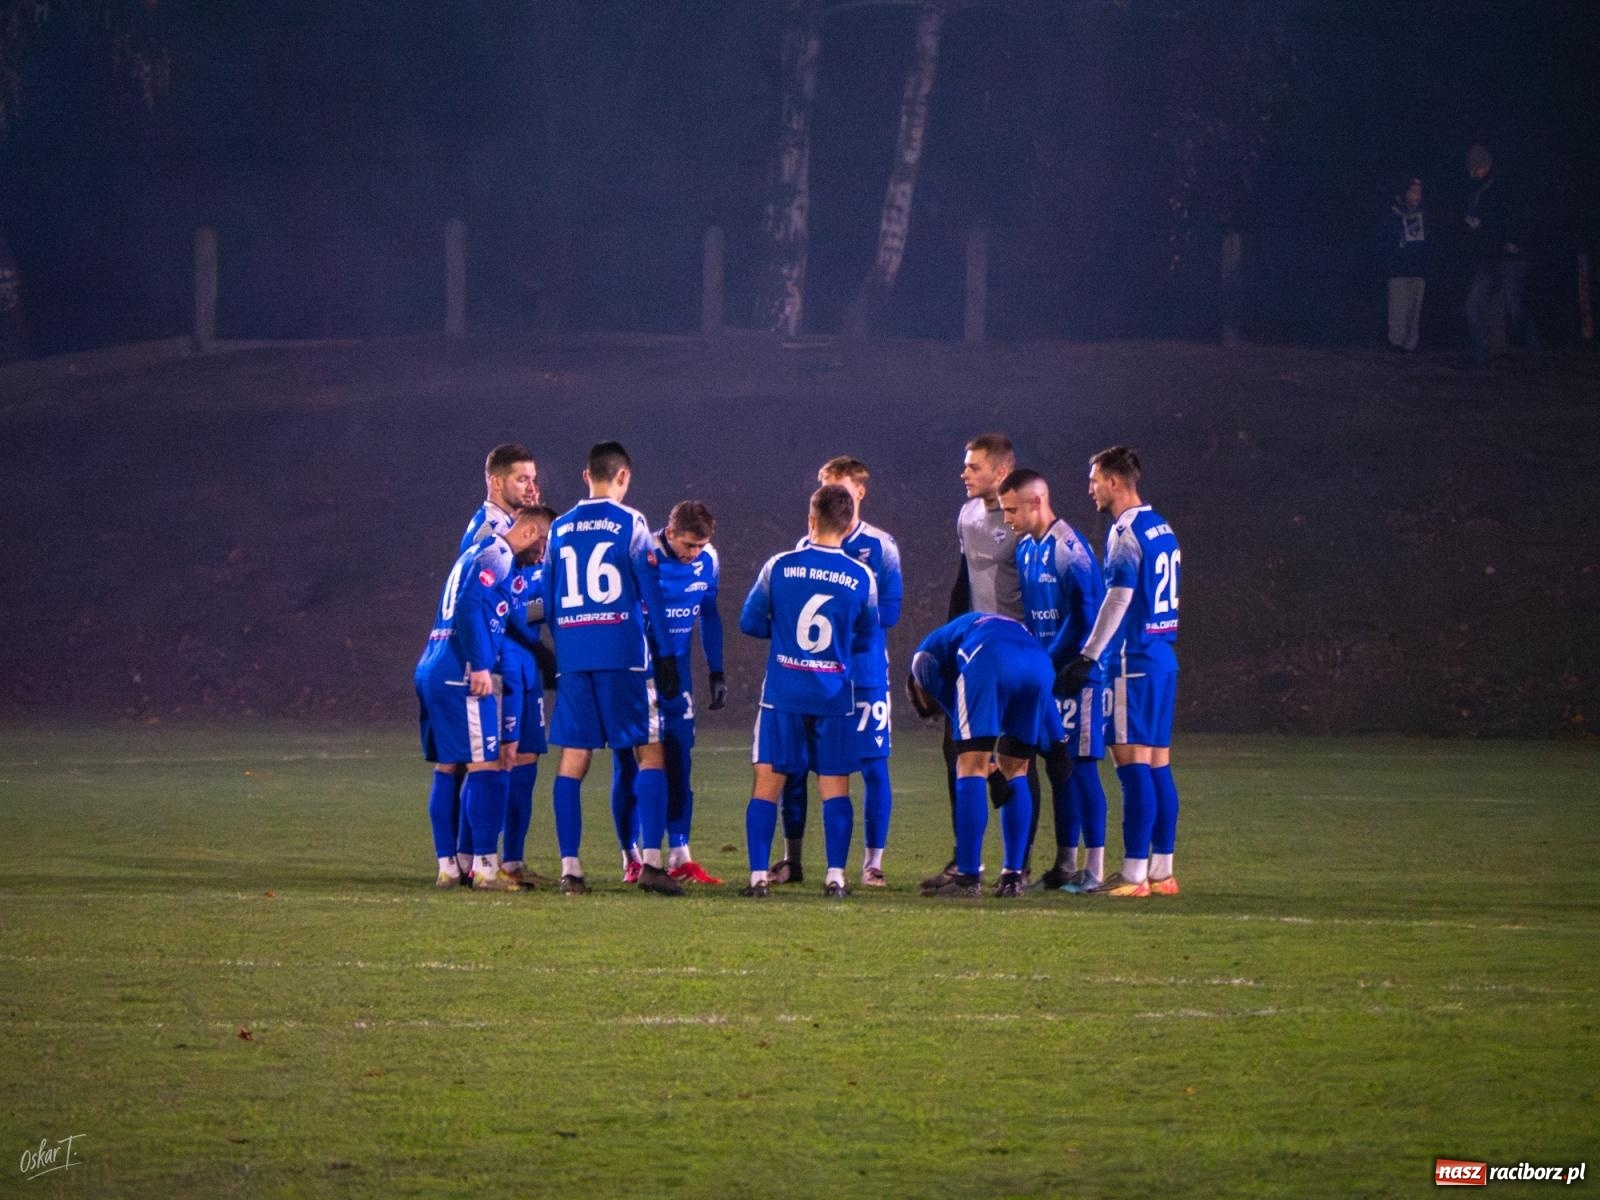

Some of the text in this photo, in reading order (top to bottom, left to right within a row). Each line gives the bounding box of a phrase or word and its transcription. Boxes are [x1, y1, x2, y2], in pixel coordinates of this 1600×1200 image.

[560, 542, 622, 608] 16
[784, 566, 859, 591] UNIA RACIBÓRZ
[796, 593, 834, 654] 6
[855, 700, 888, 732] 79
